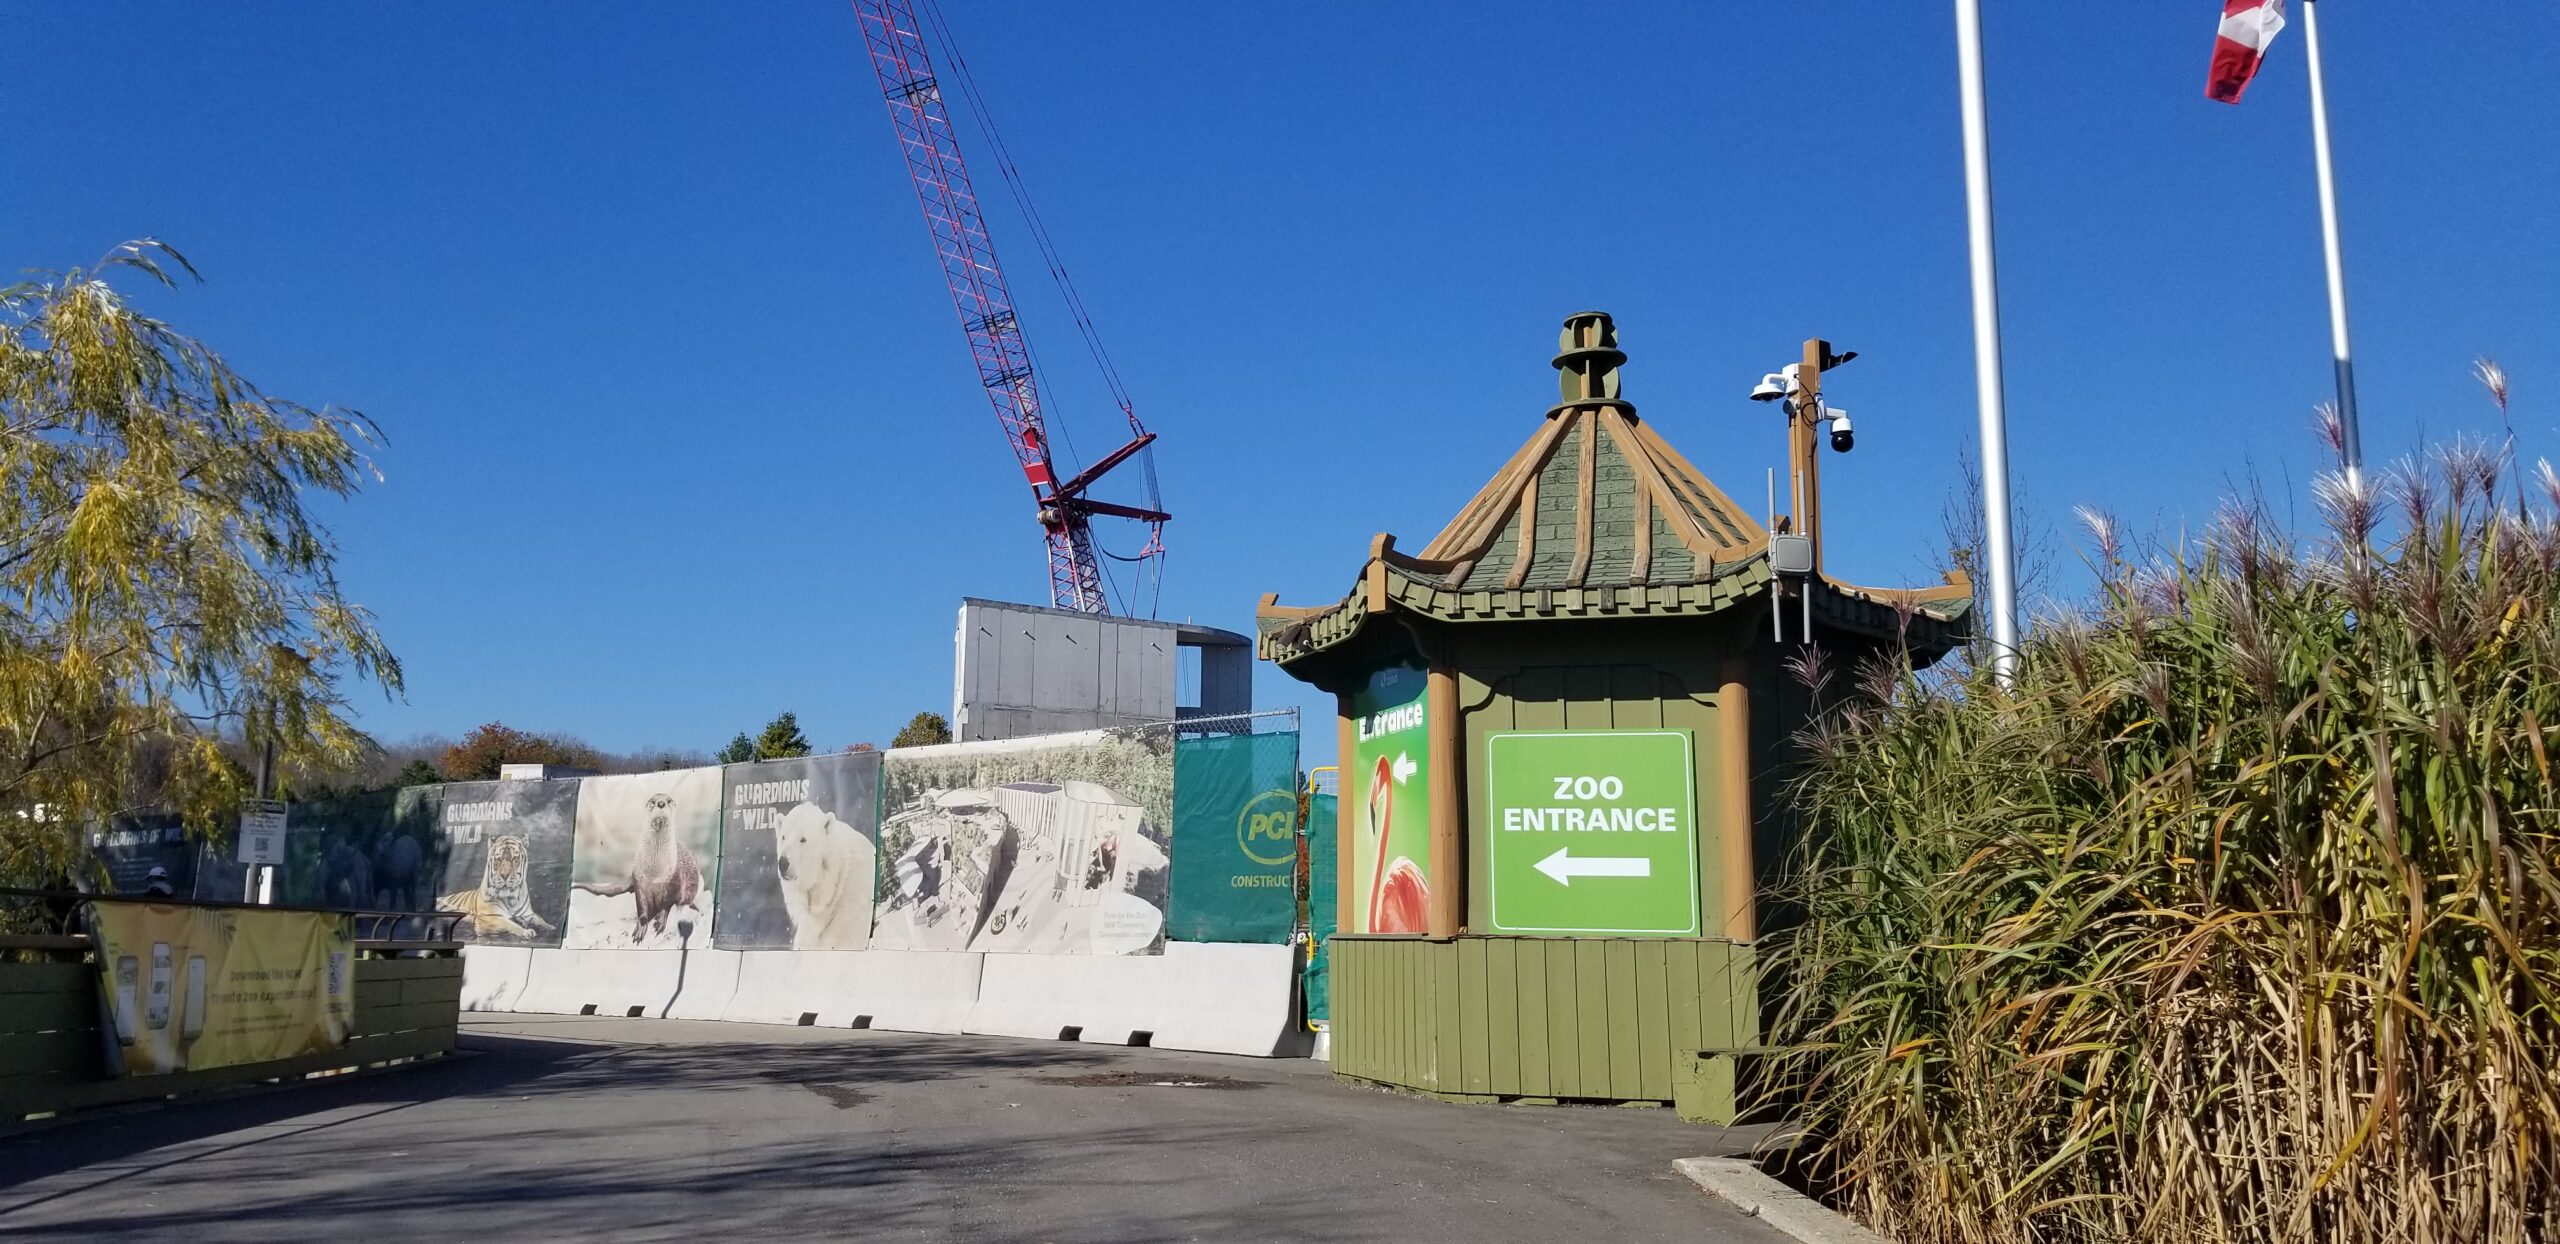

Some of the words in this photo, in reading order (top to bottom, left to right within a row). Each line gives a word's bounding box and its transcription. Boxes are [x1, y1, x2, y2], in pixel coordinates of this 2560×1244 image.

[734, 778, 810, 806] GUARDIANS
[1553, 776, 1624, 801] ZOO
[446, 801, 513, 823] GUARDIANS
[732, 809, 742, 820] OF
[742, 807, 778, 830] WILD
[1503, 807, 1677, 833] ENTRANCE
[92, 830, 147, 848] GUARDIANS
[149, 828, 162, 844] OF
[453, 823, 482, 845] WILD
